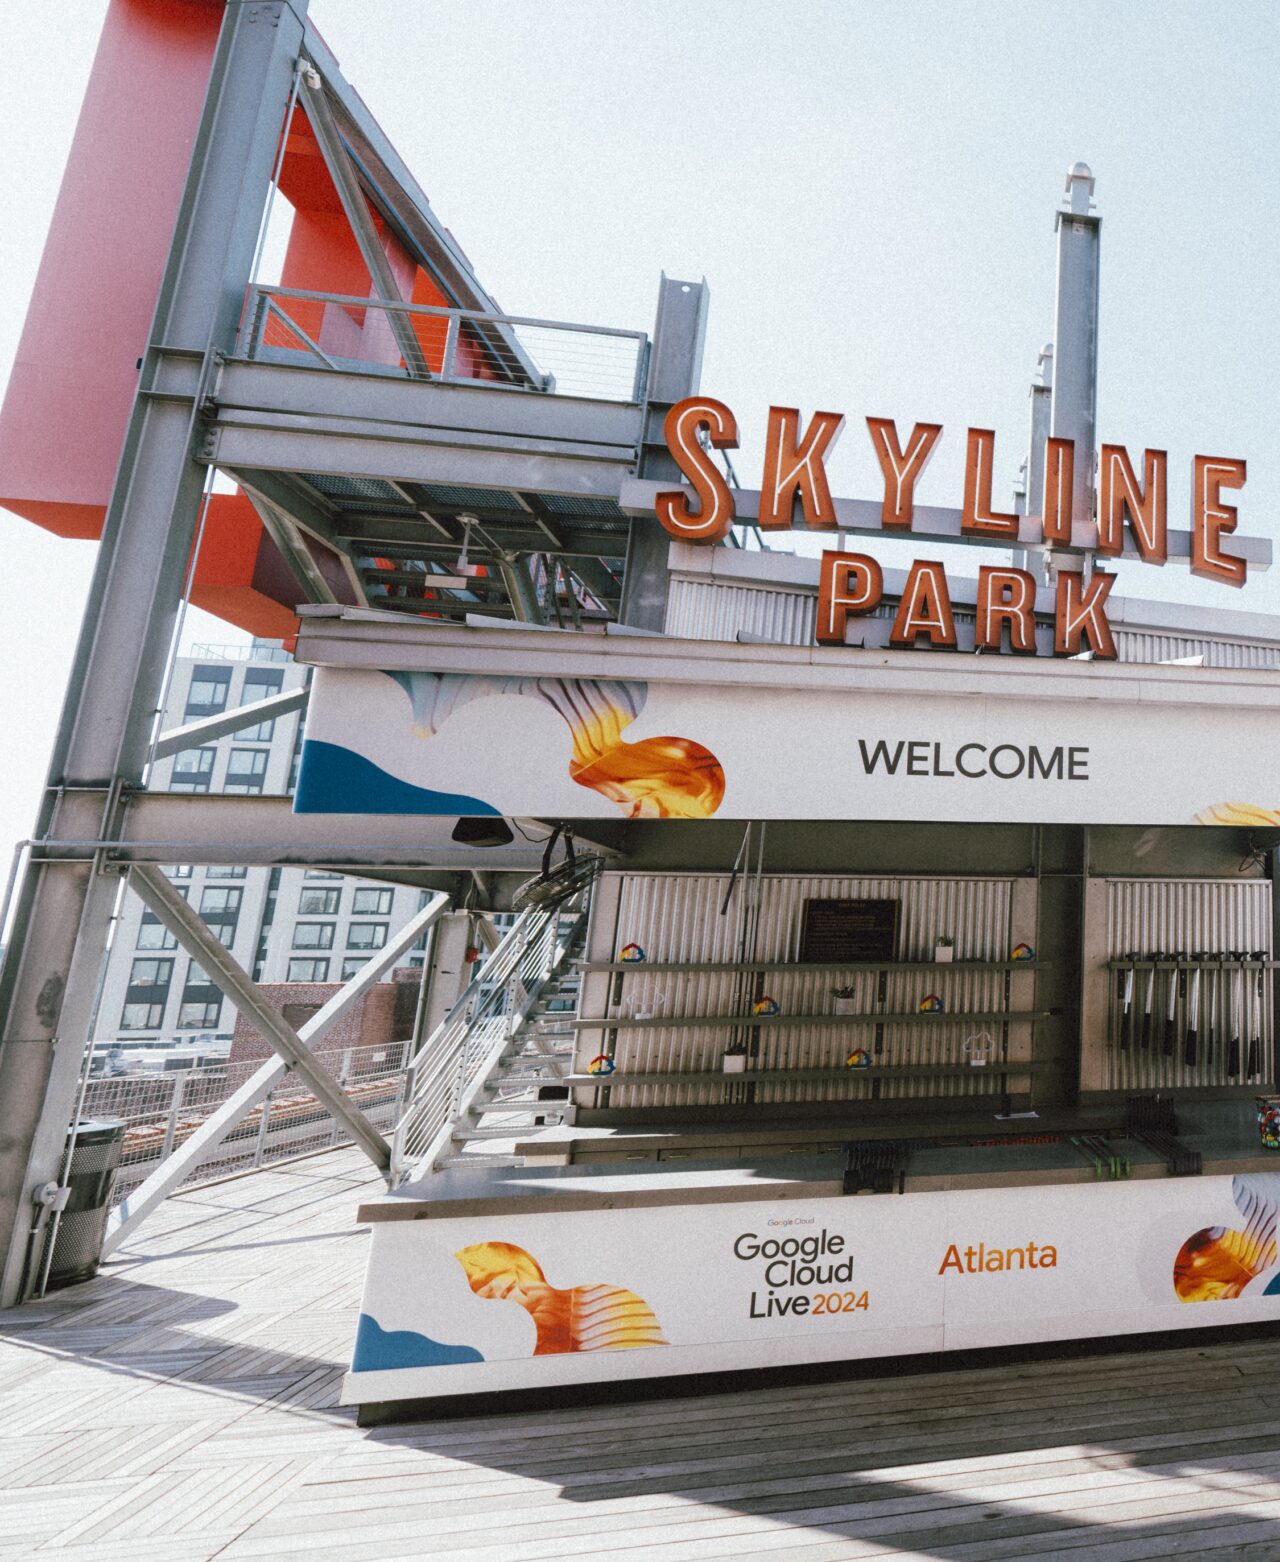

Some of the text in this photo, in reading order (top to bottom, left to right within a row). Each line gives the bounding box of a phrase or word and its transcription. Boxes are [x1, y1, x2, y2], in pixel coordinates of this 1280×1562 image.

[655, 396, 1247, 588] SKYLINE
[815, 550, 1118, 661] PARK
[858, 739, 1090, 780] WELCOME
[767, 1216, 814, 1227] Google Cloud
[733, 1228, 845, 1264] Google
[938, 1241, 1057, 1276] Atlanta
[764, 1255, 854, 1288] Cloud
[750, 1290, 869, 1319] Live 2024
